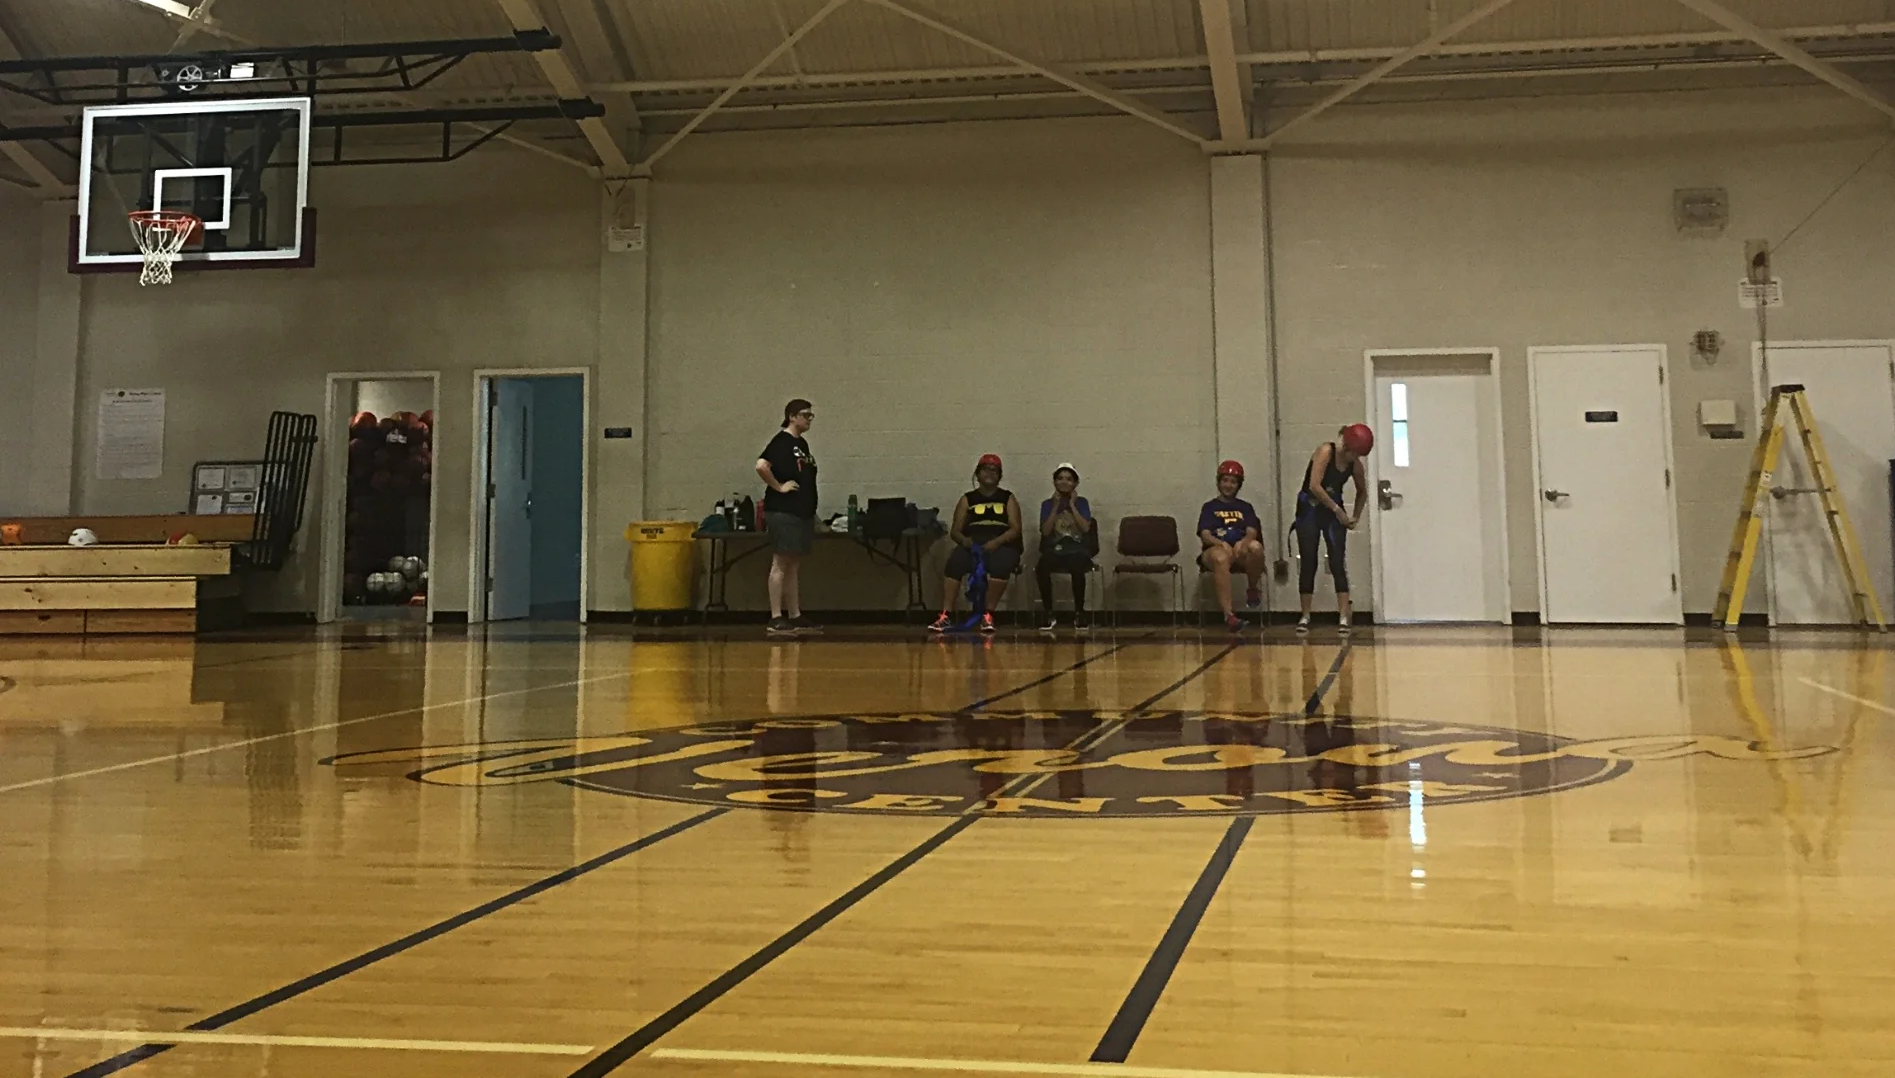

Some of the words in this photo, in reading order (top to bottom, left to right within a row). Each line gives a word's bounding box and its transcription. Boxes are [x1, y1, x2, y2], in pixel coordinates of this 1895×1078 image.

[677, 711, 1502, 736] COMMUNITY
[321, 733, 1848, 787] Verona
[725, 781, 1512, 813] CENTER
